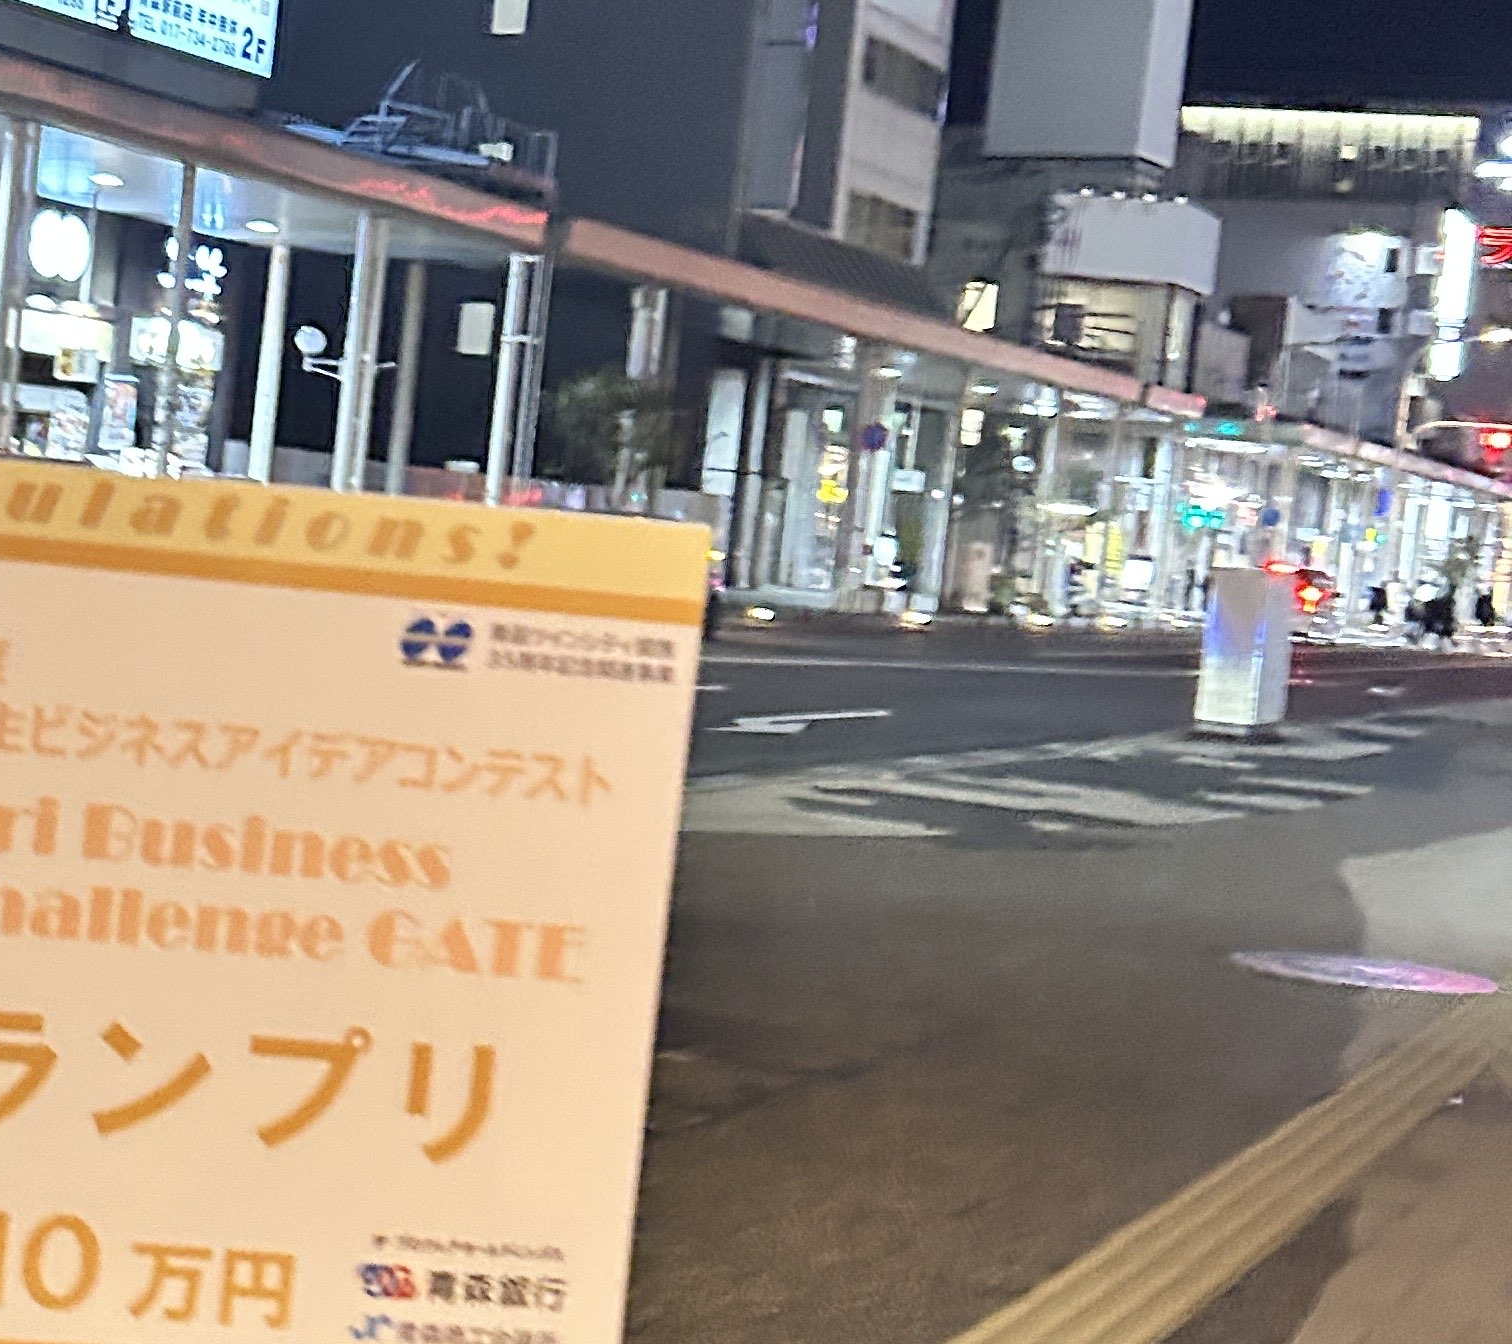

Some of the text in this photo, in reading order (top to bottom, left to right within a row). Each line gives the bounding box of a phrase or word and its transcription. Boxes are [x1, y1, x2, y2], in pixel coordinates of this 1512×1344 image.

[241, 26, 267, 64] 2F
[82, 800, 453, 891] Business
[366, 906, 588, 984] GATE
